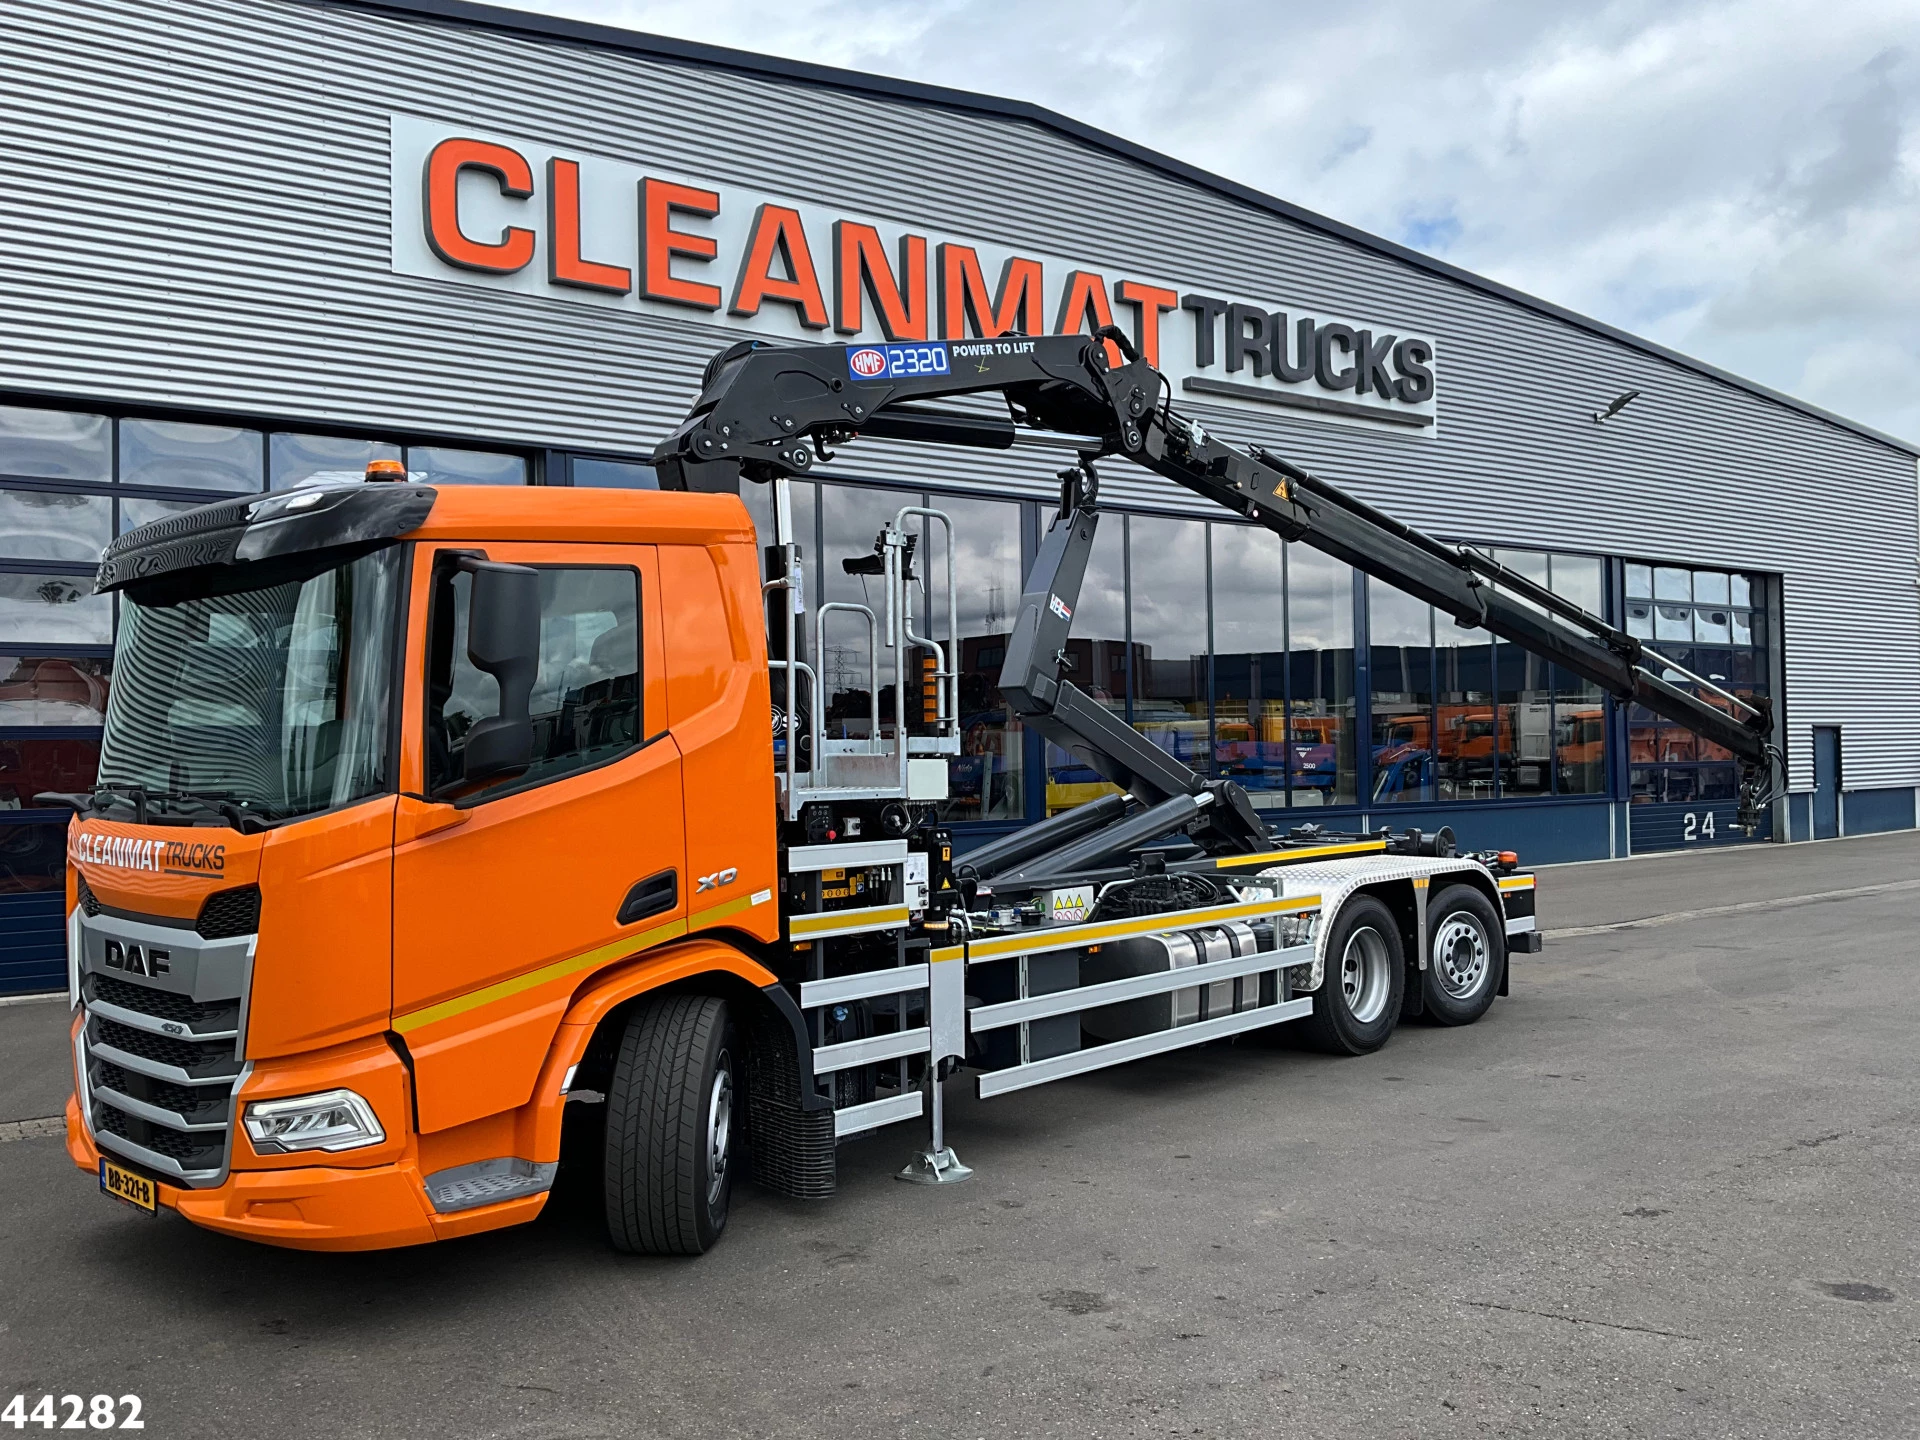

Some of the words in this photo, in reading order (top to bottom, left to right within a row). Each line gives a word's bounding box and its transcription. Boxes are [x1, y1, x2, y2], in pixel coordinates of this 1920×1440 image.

[423, 137, 1178, 370] CLEANMAT
[1182, 294, 1434, 403] TRUCKS
[852, 352, 882, 374] HMF
[889, 348, 947, 374] 2320
[952, 344, 994, 357] POWER
[997, 343, 1011, 354] TO
[1014, 342, 1035, 354] LIFT
[1684, 811, 1716, 840] 24
[78, 833, 165, 872] CLEANMAT
[166, 841, 225, 870] TRUCKS
[696, 867, 738, 894] XD
[105, 939, 172, 980] DAF
[108, 1167, 150, 1204] BB-321-B
